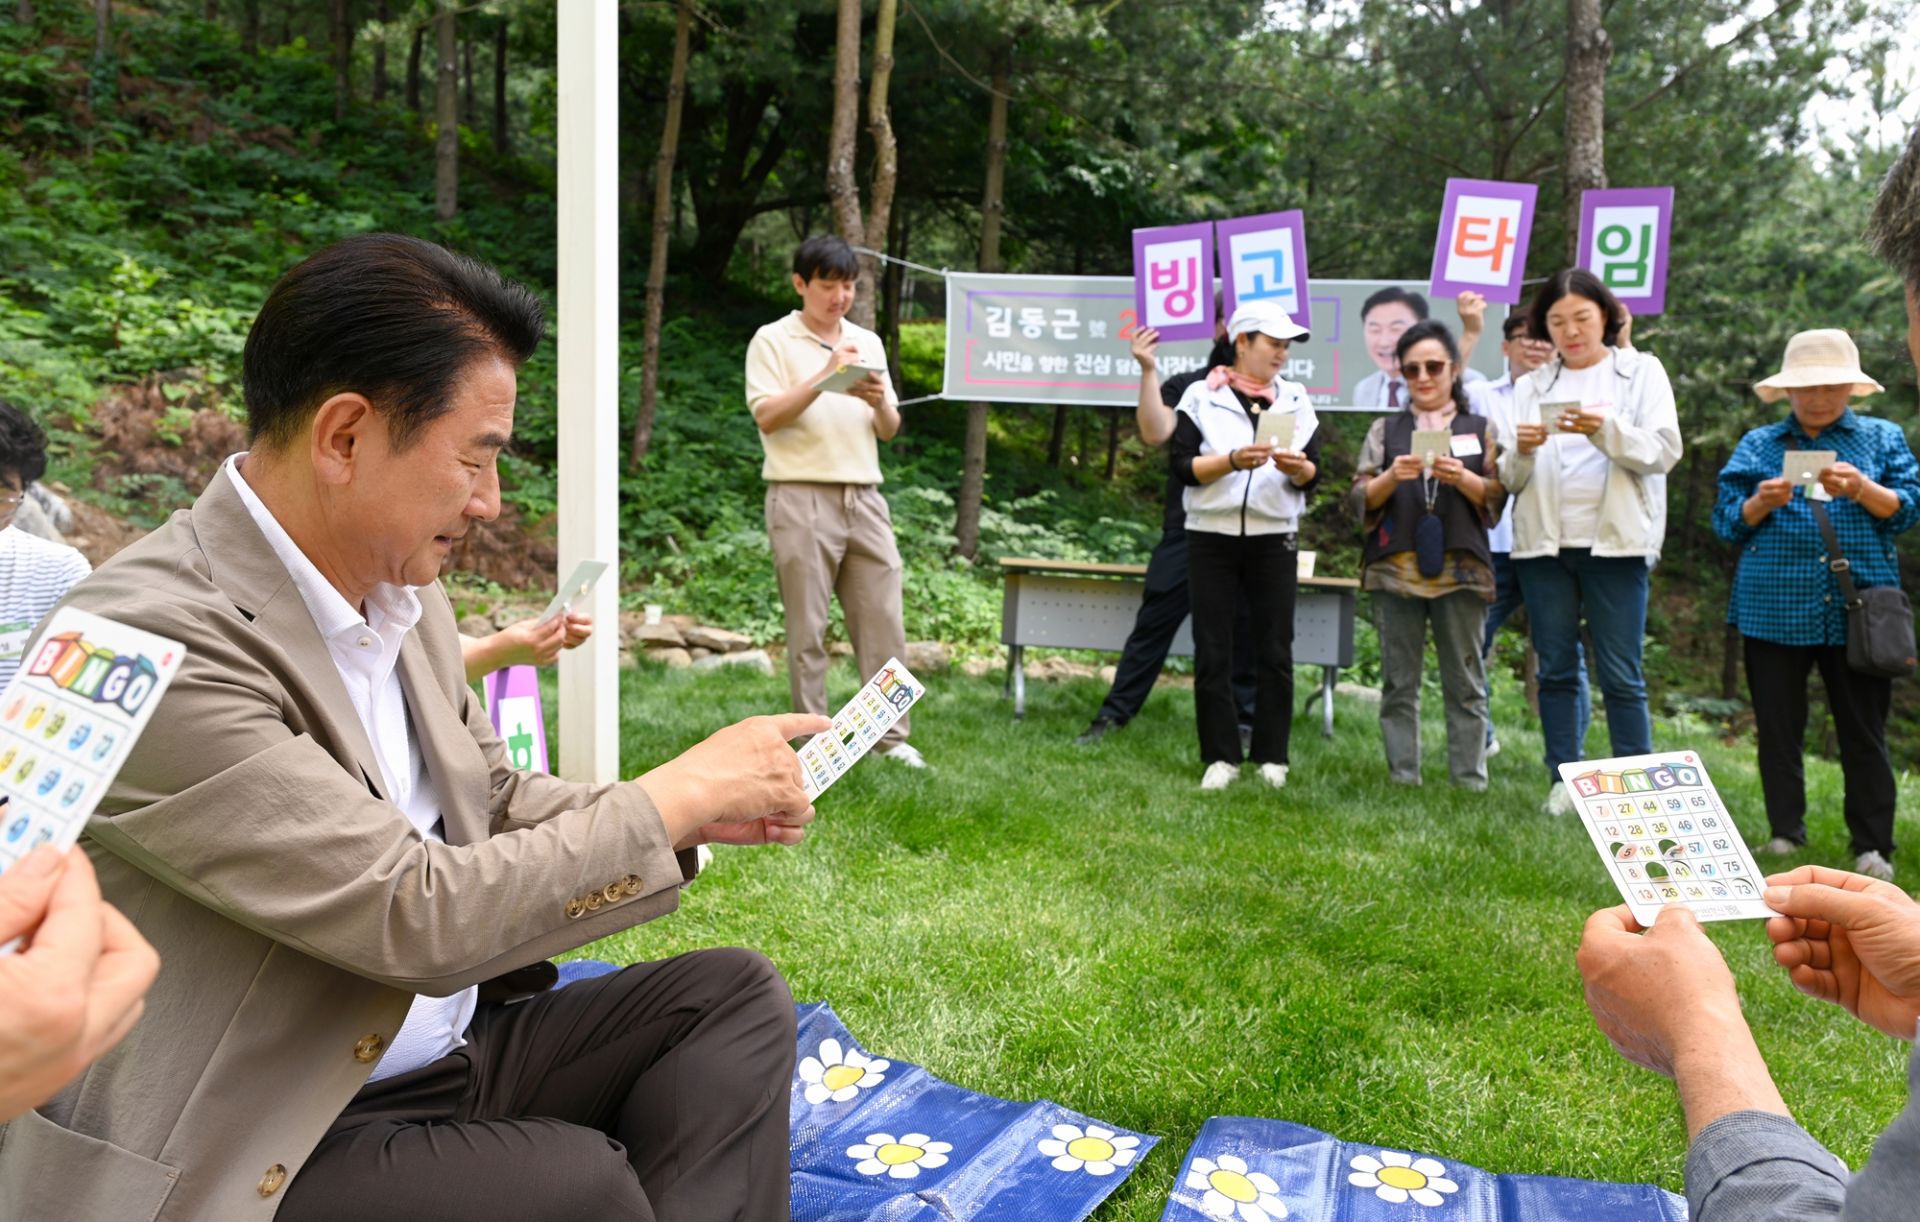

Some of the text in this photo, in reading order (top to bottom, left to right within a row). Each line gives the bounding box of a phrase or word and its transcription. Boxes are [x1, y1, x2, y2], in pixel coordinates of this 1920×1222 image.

[1454, 216, 1515, 272] 타
[1597, 224, 1652, 287] 임
[1151, 256, 1197, 318] 빙
[1239, 249, 1293, 301] 고
[985, 307, 1080, 340] 김동근
[983, 351, 1034, 373] 시민을
[1039, 356, 1069, 373] 향한
[1074, 354, 1112, 376] 진심
[31, 641, 152, 709] BINGO
[1576, 770, 1697, 796] BINGO
[1617, 803, 1631, 814] 27
[1642, 801, 1657, 811] 44
[1667, 798, 1681, 809] 59
[1691, 796, 1706, 807] 65
[1605, 827, 1620, 836] 12
[1628, 825, 1643, 835] 28
[1678, 820, 1692, 830] 46
[1702, 817, 1717, 828] 68
[1640, 845, 1654, 855] 16
[1688, 842, 1701, 853] 57
[1713, 839, 1729, 850] 62
[1700, 864, 1713, 875] 47
[1724, 861, 1740, 872] 75
[1638, 889, 1653, 899] 13
[1662, 888, 1678, 898] 26
[1735, 885, 1752, 895] 73
